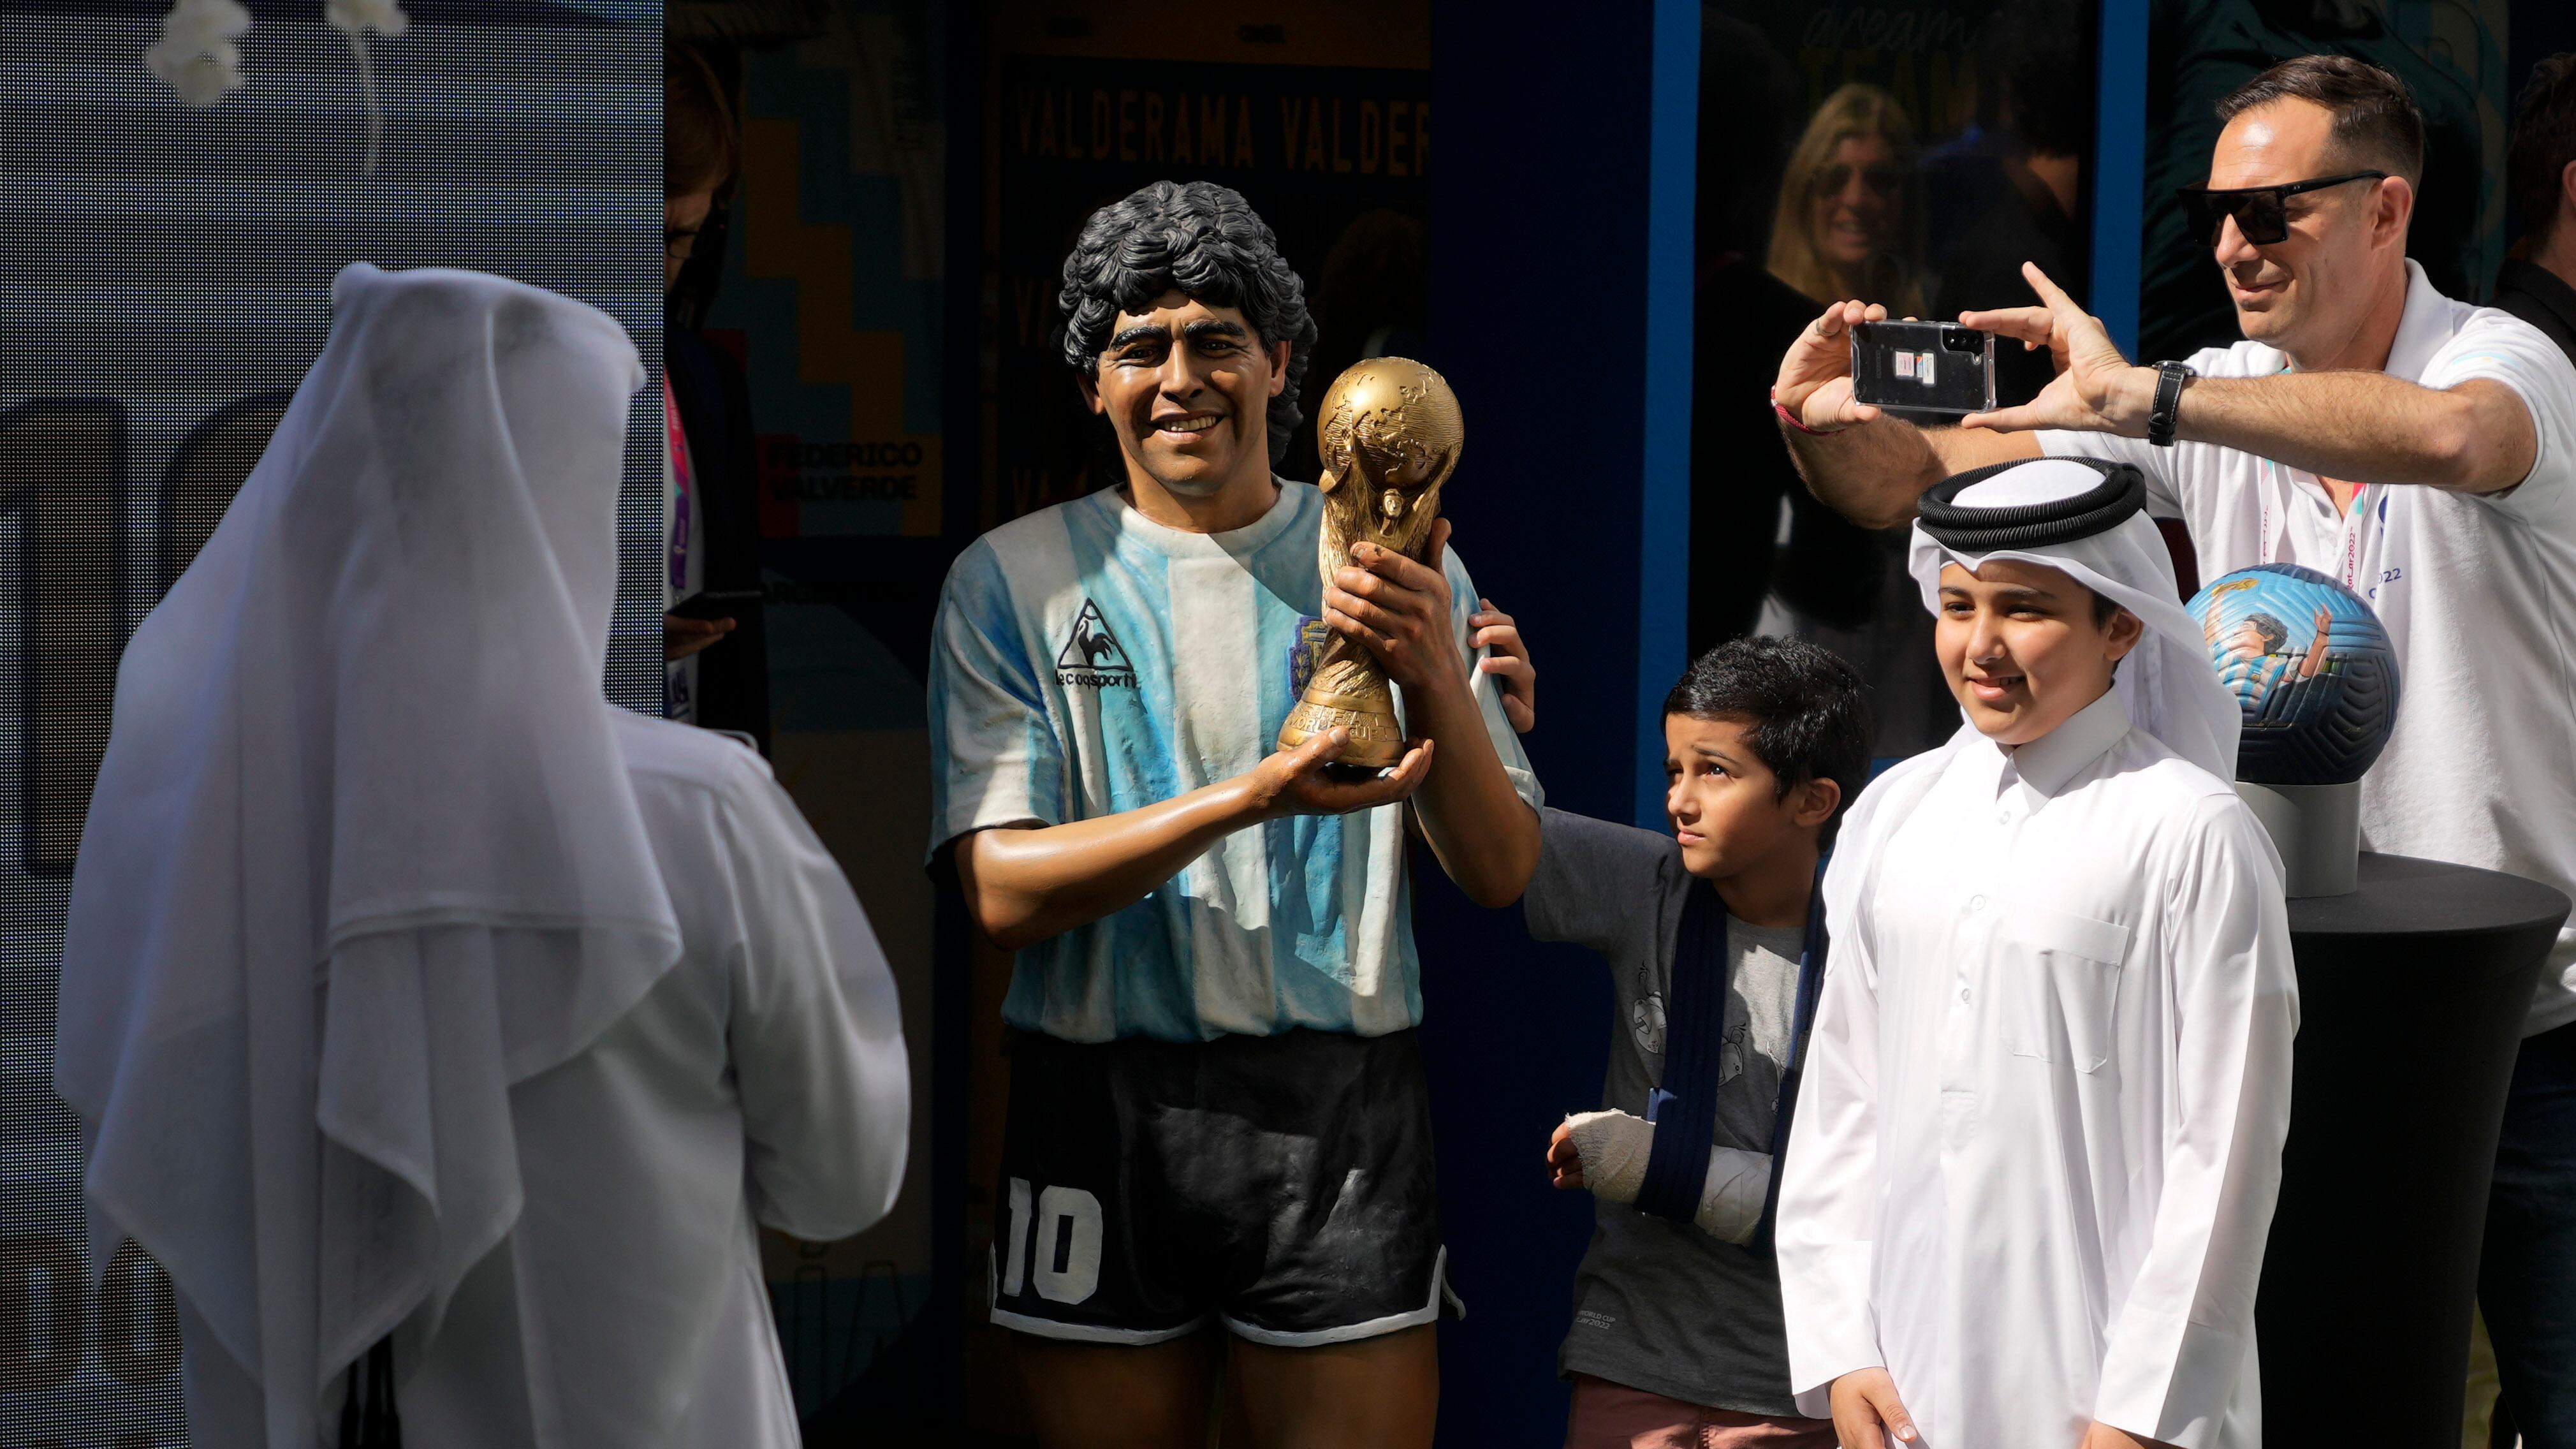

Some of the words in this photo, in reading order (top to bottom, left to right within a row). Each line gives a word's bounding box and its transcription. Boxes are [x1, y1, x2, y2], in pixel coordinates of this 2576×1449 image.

[1014, 86, 1255, 169] VALDERAMA
[770, 443, 922, 466] FEDERICO
[772, 475, 919, 500] VALVERDE
[2346, 533, 2356, 590] atar2022
[1003, 1176, 1104, 1305] 10
